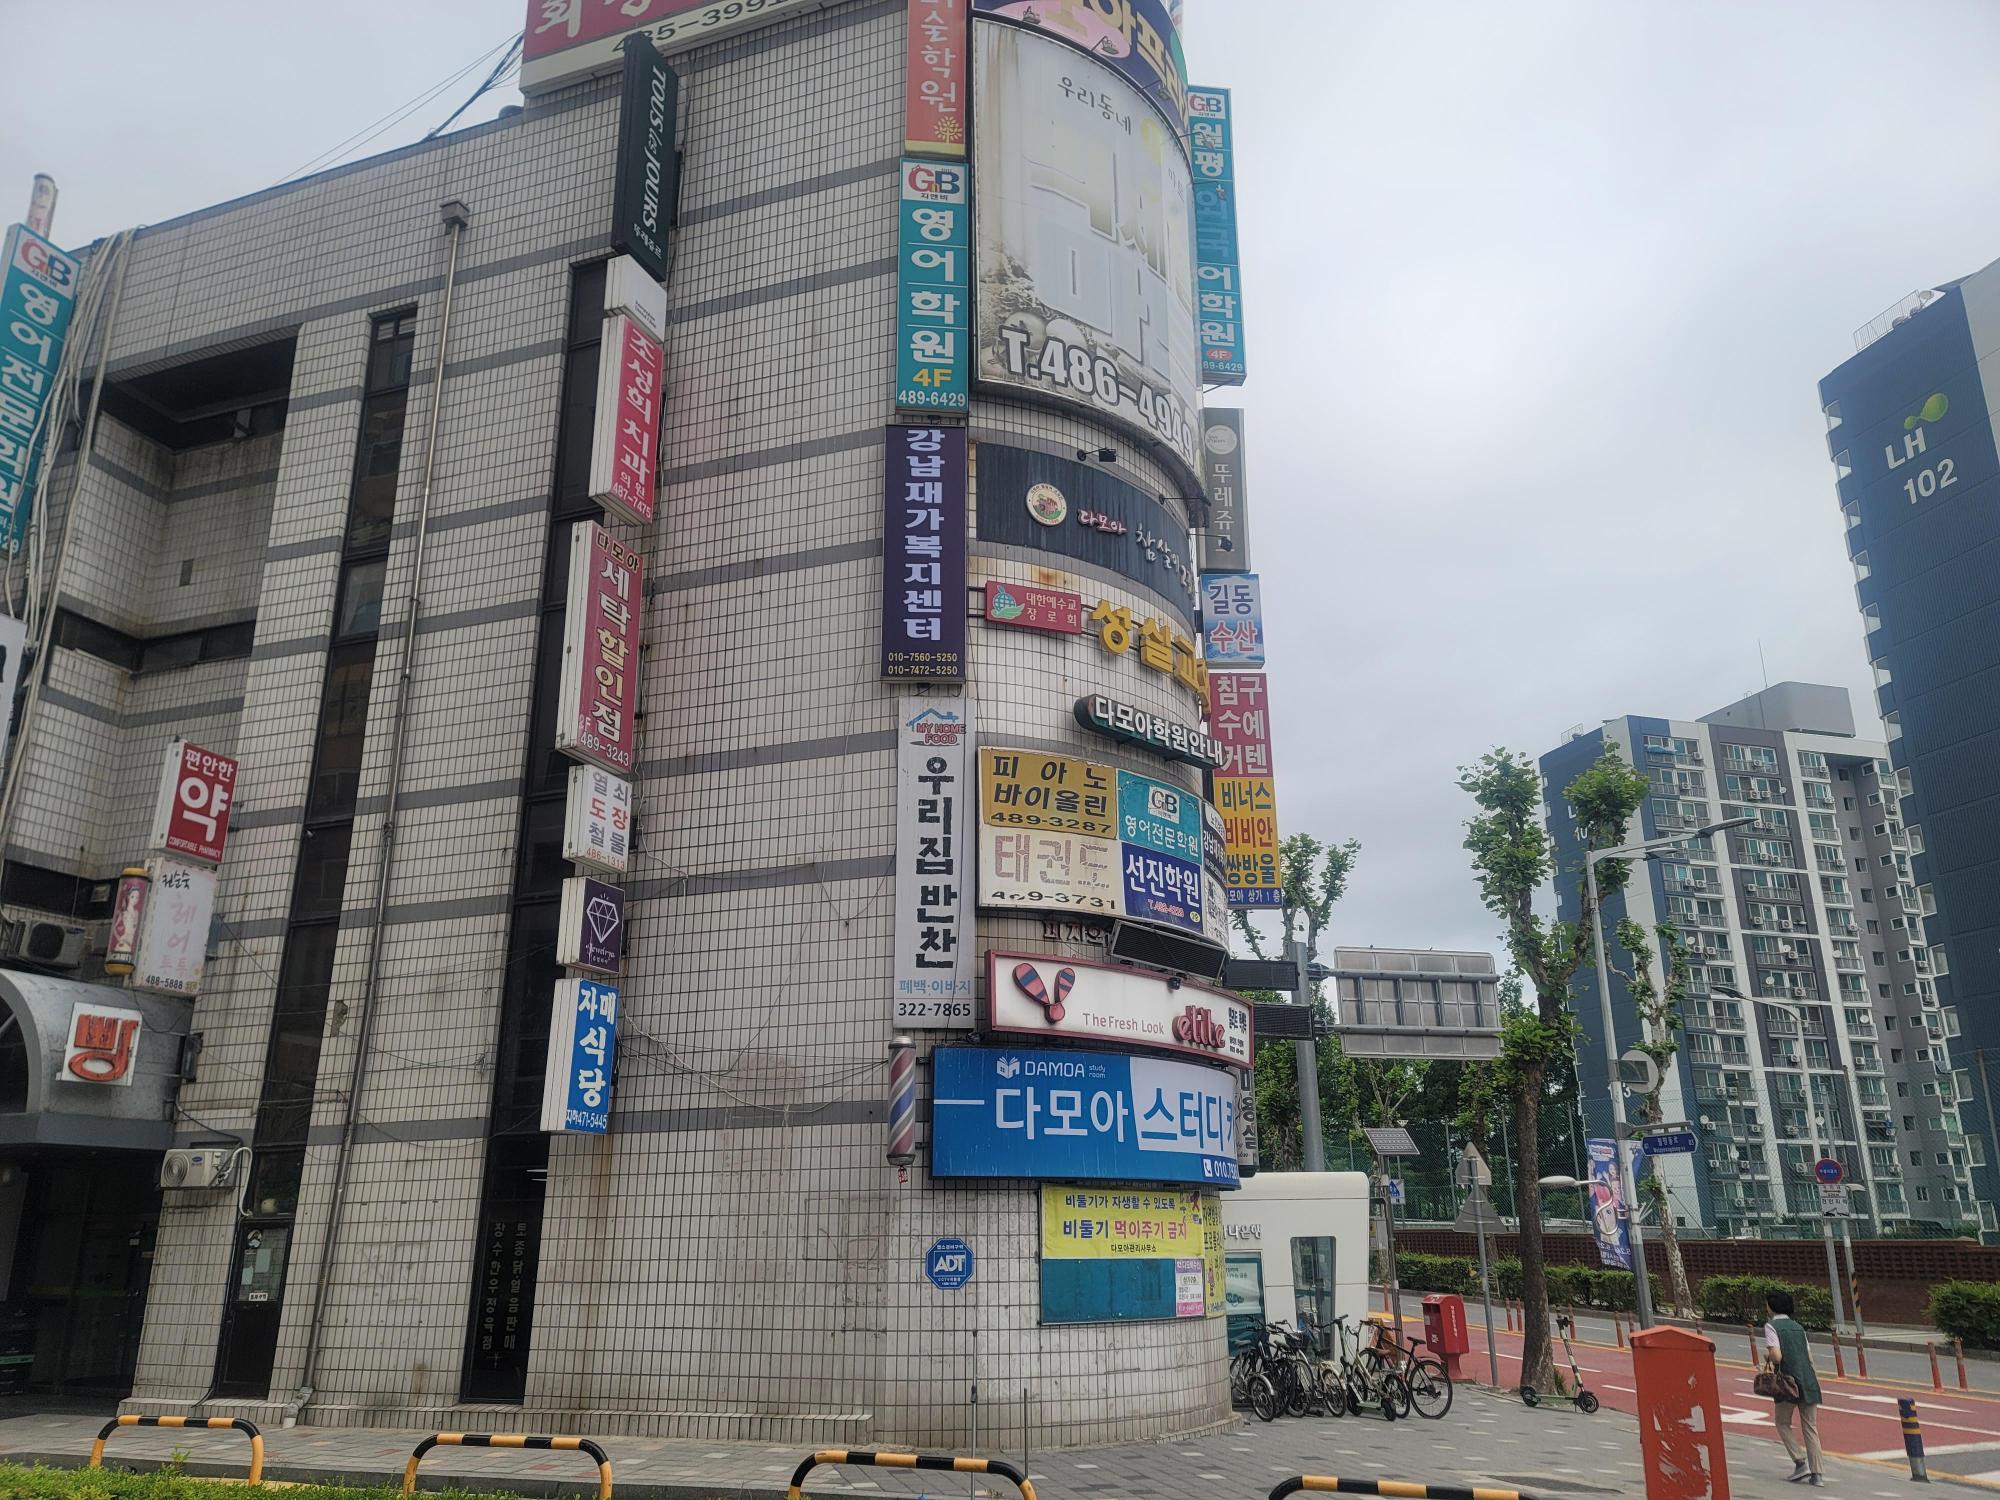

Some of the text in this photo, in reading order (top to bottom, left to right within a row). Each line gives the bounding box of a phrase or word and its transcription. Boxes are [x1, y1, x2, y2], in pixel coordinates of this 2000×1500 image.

[919, 0, 957, 113] 술학원
[651, 65, 667, 133] TOUS
[1057, 76, 1132, 135] 우리동네
[643, 149, 662, 234] JOURS
[910, 207, 961, 366] 영어학원
[912, 367, 953, 388] 4F
[1202, 360, 1244, 372] 89-6429
[897, 390, 967, 407] 489-6429
[1000, 326, 1196, 467] T.486-4949
[1885, 427, 1927, 470] LH
[1904, 458, 1957, 504] 102
[612, 482, 652, 519] 487-7475
[903, 429, 945, 641] 강남재가복지센터
[1078, 508, 1128, 536] 다모아
[594, 532, 640, 575] 다모아
[1026, 592, 1077, 611] 대한예수교
[1209, 584, 1254, 615] 길동
[591, 557, 633, 744] 세탁할인점
[1210, 620, 1258, 652] 수산
[888, 652, 957, 662] 010-7560-5250
[888, 665, 957, 675] 010-7472-5250
[1217, 676, 1263, 706] 침구
[916, 724, 967, 734] MY HOME
[925, 733, 957, 744] FOOD
[1095, 696, 1223, 766] 다모아학원안내
[1218, 710, 1265, 740] 수예
[185, 749, 234, 782] 편안한
[579, 731, 630, 767] 489-3243
[593, 771, 629, 807] 열쇠
[994, 783, 1107, 818] 바이올린
[1221, 781, 1272, 812] 비너스
[180, 776, 229, 843] 약
[589, 797, 628, 831] 도장
[991, 812, 1112, 834] 489-3287
[588, 821, 626, 857] 철물
[1125, 814, 1200, 859] 영어전문학원
[1224, 816, 1273, 851] 비비안
[586, 847, 625, 871] 486-1313
[1226, 852, 1277, 886] 쌍방울
[1125, 853, 1201, 908] 선진학원
[1227, 888, 1244, 903] 모아
[145, 974, 183, 990] 488-5888
[898, 1002, 971, 1018] 322-7865
[1083, 1012, 1165, 1035] The Fresh Look
[1173, 1005, 1226, 1048] elite
[579, 1026, 607, 1108] 식당
[1025, 1060, 1085, 1078] DAMOA
[1088, 1063, 1106, 1073] study
[996, 1086, 1128, 1143] 다모아
[1065, 1195, 1176, 1210] 비둘기가 자생할 수 있도록
[1063, 1219, 1187, 1240] 비둘기 먹이주기 금지
[934, 1255, 966, 1272] ADT
[1110, 1243, 1157, 1253] 다모아관리사무소
